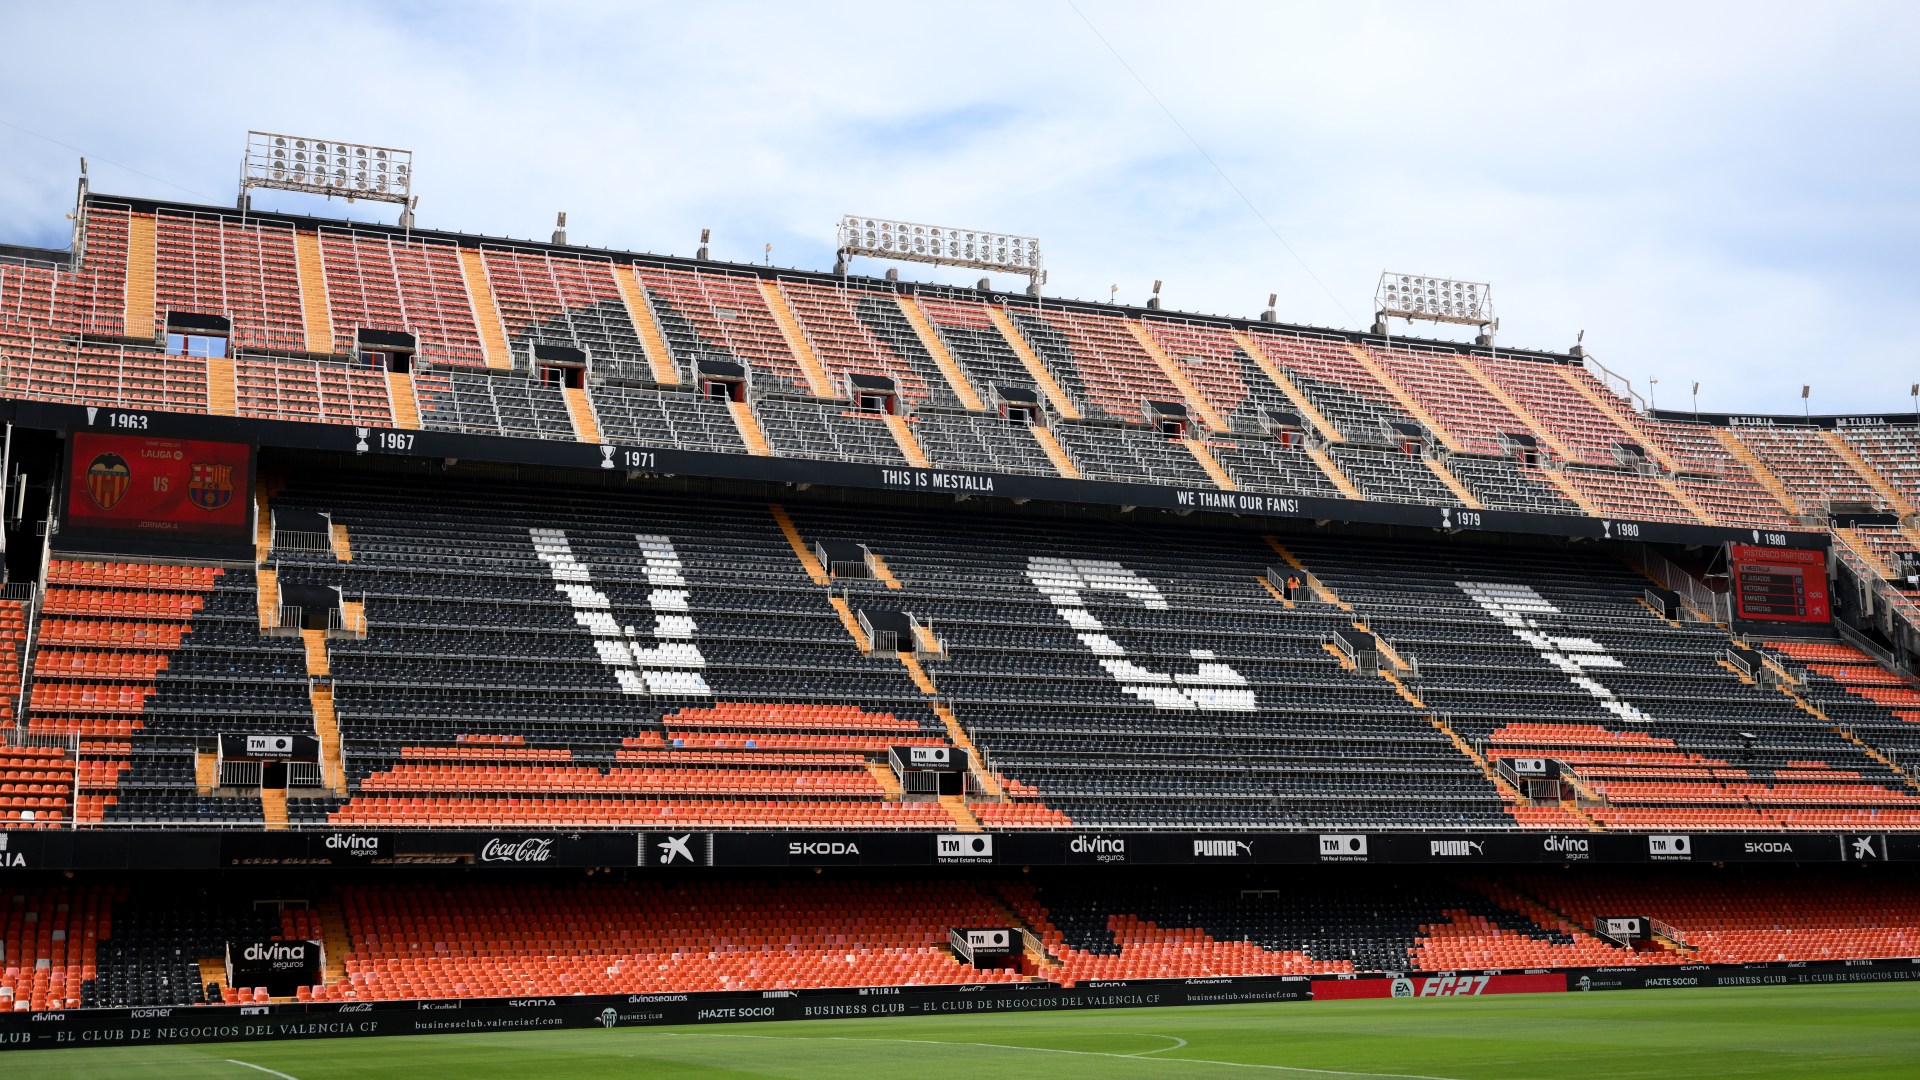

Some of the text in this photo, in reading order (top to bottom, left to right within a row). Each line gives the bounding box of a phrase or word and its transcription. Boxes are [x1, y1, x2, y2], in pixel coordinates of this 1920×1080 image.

[109, 413, 148, 429] 1963
[1741, 417, 1775, 426] TURIA
[1849, 417, 1886, 426] TURIA
[379, 432, 415, 450] 1967
[141, 449, 172, 459] LALIGA
[624, 451, 655, 468] 1971
[153, 477, 169, 492] VS
[882, 469, 994, 492] THIS IS MESTALLA
[1177, 490, 1299, 513] WE THANK OUR FANS!
[1456, 511, 1481, 526] 1979
[138, 521, 172, 529] JORNADA
[1616, 523, 1639, 537] 1980
[1764, 533, 1786, 546] 1980
[1781, 551, 1815, 561] PARTIDOS
[1745, 605, 1772, 613] DERROTAS
[250, 740, 266, 749] TM
[913, 750, 927, 759] TM
[325, 833, 378, 849] divina
[940, 840, 960, 852] TM
[1070, 835, 1125, 853] divina
[1322, 840, 1339, 851] TM
[1543, 835, 1588, 851] divina
[1651, 840, 1667, 851] TM
[350, 849, 378, 857] seguros
[1193, 840, 1237, 857] PUMA
[1430, 840, 1470, 856] PUMA
[1096, 854, 1125, 862] seguros
[1566, 853, 1589, 861] seguros
[970, 935, 984, 944] TM
[244, 943, 305, 961] divina
[272, 961, 304, 970] seguros
[1645, 977, 1698, 987] ¡HAZTE SOCIO!
[1717, 976, 1761, 985] BUSINESS
[1763, 975, 1787, 983] CLUB
[1799, 974, 1810, 983] EL
[1811, 973, 1834, 982] CLUB
[1836, 973, 1847, 981] DE
[1849, 971, 1892, 981] NEGOCIOS
[1894, 971, 1910, 979] DEL
[1395, 982, 1411, 992] EA
[628, 994, 687, 1003] divinaseguros
[1187, 991, 1298, 1001] businessclub.valenciacf.com
[804, 1004, 867, 1016] BUSINESS
[872, 1003, 905, 1013] CLUB
[923, 1002, 938, 1011] EL
[941, 1000, 973, 1010] CLUB
[977, 1000, 993, 1009] DE
[996, 998, 1057, 1008] NEGOCIOS
[1061, 997, 1083, 1006] DEL
[1087, 995, 1142, 1005] VALENCIA
[1146, 994, 1160, 1003] CF
[32, 1012, 65, 1022] divina
[619, 1013, 647, 1021] BUSINESS
[697, 1007, 775, 1020] ¡HAZTE SOCIO!
[415, 1017, 563, 1029] businessclub.valenciacf.com
[57, 1031, 76, 1042] EL
[82, 1029, 124, 1041] CLUB
[130, 1028, 151, 1039] DE
[157, 1026, 239, 1038] NEGOCIOS
[245, 1025, 274, 1036] DEL
[280, 1023, 354, 1035] VALENCIA
[360, 1021, 378, 1032] CF
